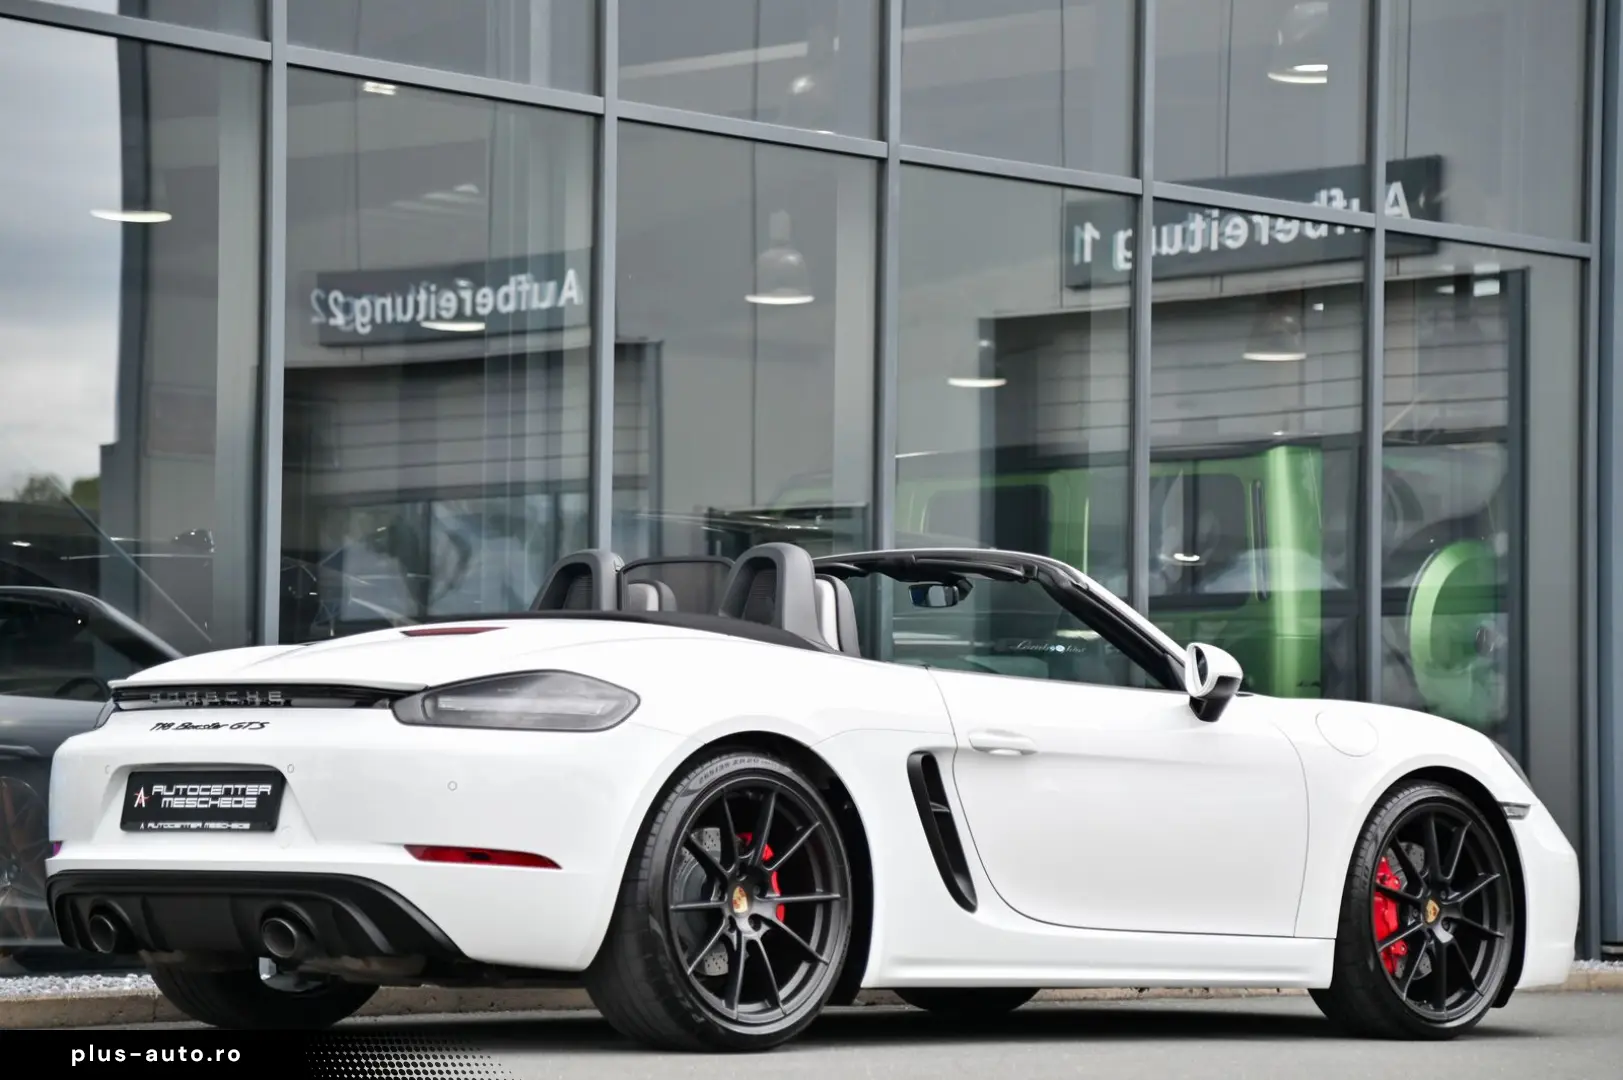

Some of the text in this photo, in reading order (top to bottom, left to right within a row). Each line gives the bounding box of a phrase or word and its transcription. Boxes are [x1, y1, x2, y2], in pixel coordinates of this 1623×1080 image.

[149, 690, 283, 704] PORSCHE
[150, 720, 270, 732] 718 Boxster GTS
[151, 784, 273, 796] AUTOCENTER
[160, 796, 258, 809] MESCHEDE
[146, 821, 203, 829] AUTOCENTER
[203, 821, 251, 830] MESCHEDE
